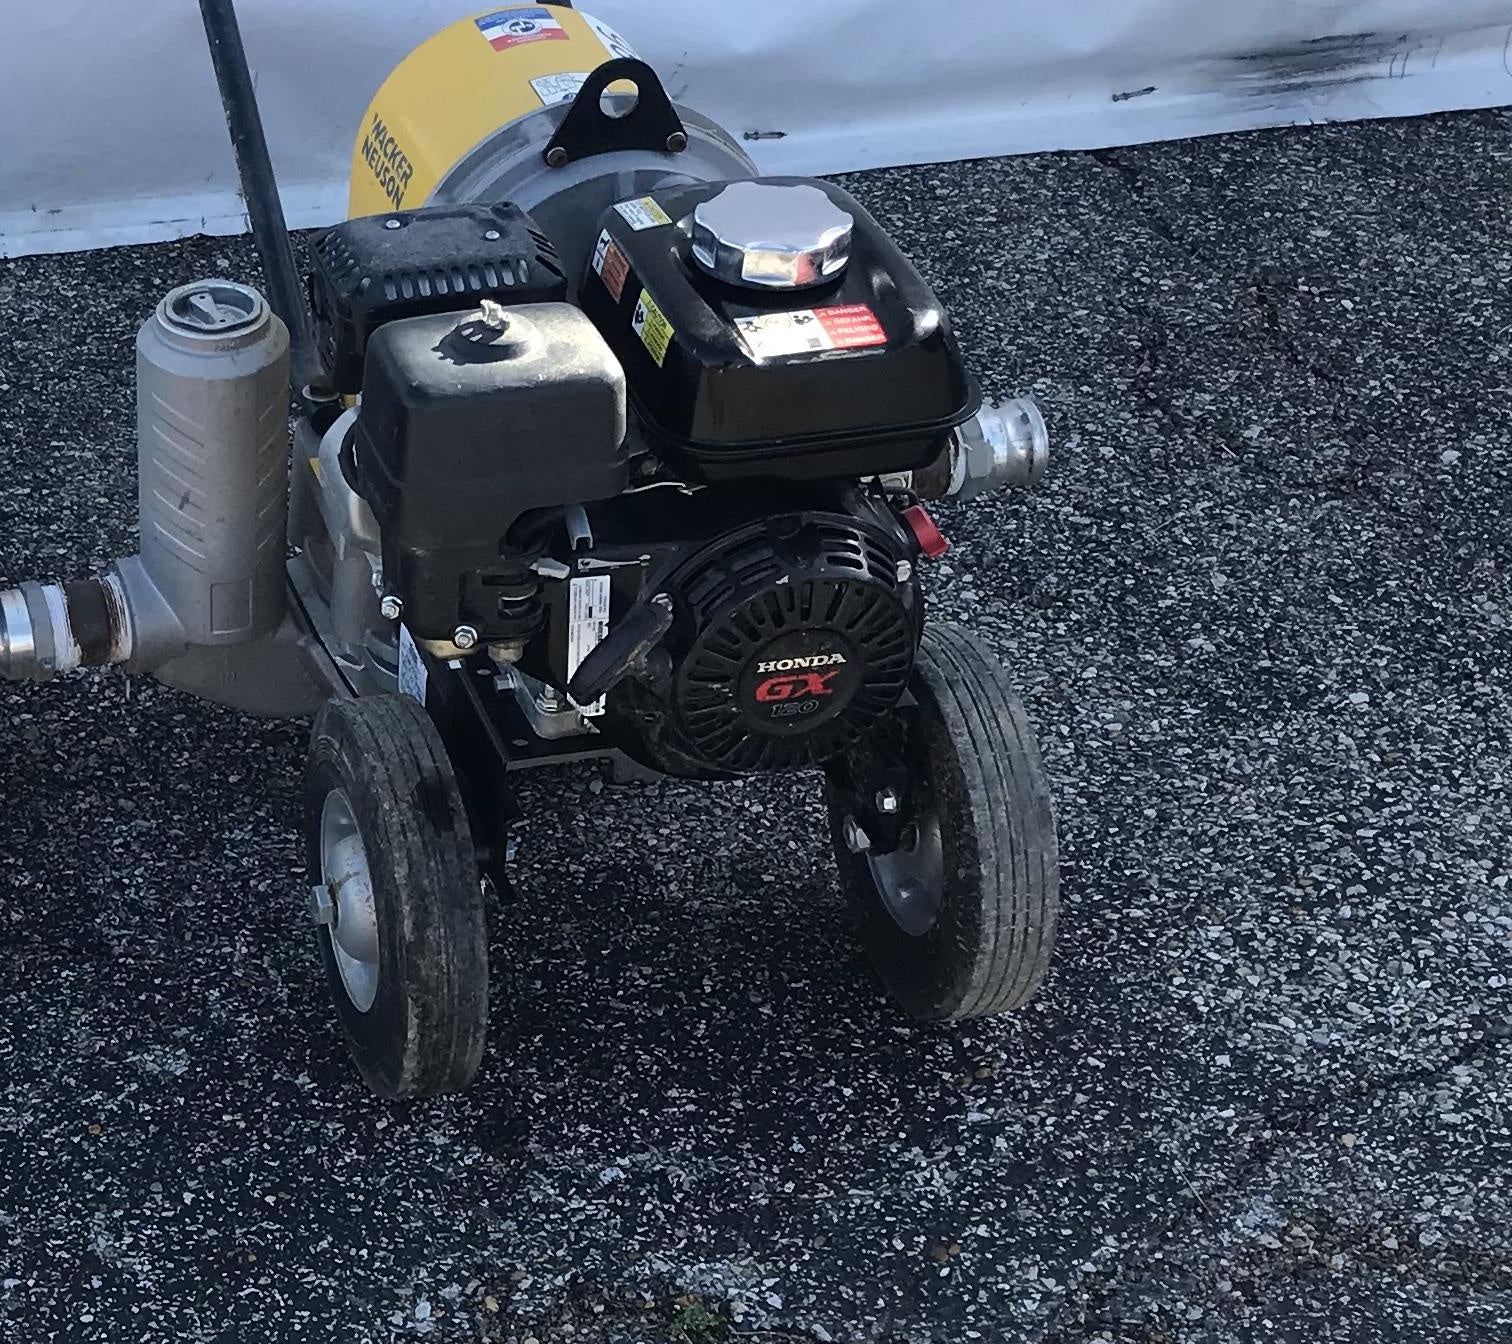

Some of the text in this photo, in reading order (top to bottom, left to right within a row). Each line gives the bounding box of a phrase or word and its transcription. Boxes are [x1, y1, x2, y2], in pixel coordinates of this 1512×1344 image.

[371, 112, 414, 191] WACKER
[361, 134, 405, 211] NEUSON
[827, 306, 869, 317] DANGER
[756, 653, 847, 673] HONDA
[755, 668, 840, 702] GX
[770, 699, 819, 718] 120
